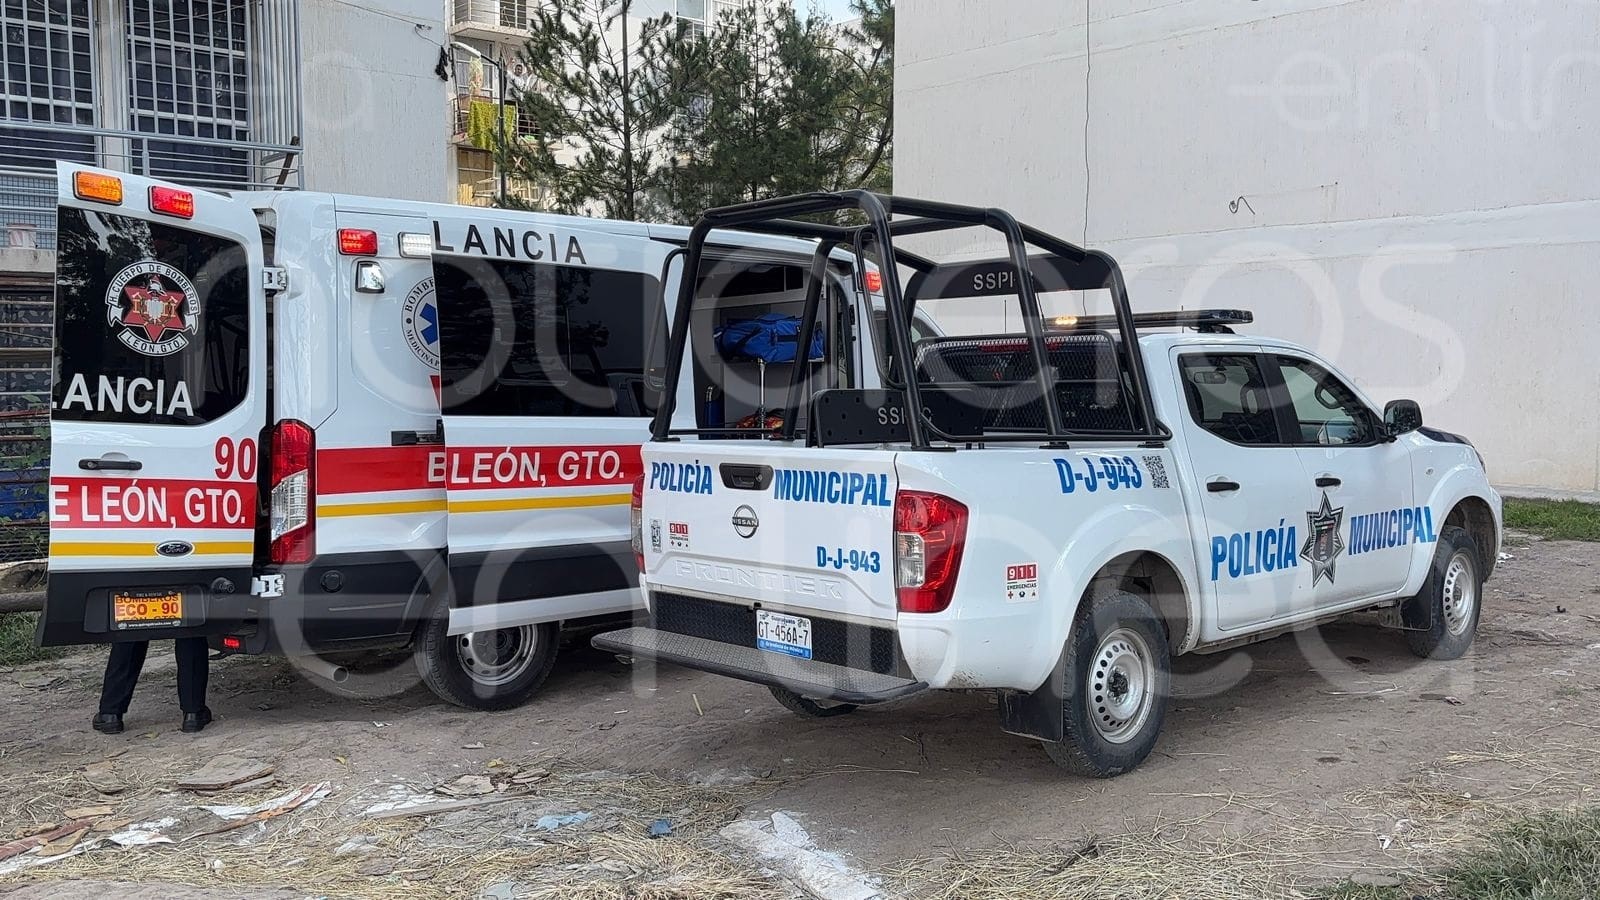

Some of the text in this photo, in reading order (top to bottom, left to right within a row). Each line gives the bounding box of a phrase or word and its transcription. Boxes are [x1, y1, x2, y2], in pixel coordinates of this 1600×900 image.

[433, 220, 587, 265] LANCIA
[113, 265, 143, 294] CUERPO
[149, 264, 164, 273] DE
[165, 268, 198, 311] BOMBEROS
[406, 329, 434, 366] MEDICINA
[51, 373, 194, 416] ANCIA
[215, 437, 257, 480] 90
[451, 446, 625, 486] LEÓN, GTO.
[650, 460, 713, 494] POLICÍA
[1053, 456, 1142, 493] D-J-943
[81, 479, 176, 528] LEÓN,
[184, 487, 245, 524] GTO.
[774, 469, 891, 506] MUNICIPAL
[670, 523, 688, 534] 911
[732, 517, 757, 525] NISSAN
[1348, 506, 1437, 555] MUNICIPAL
[816, 546, 880, 573] D-J-943
[1211, 518, 1297, 581] POLICÍA
[674, 559, 843, 600] FRONTIER
[1009, 566, 1035, 579] 911
[116, 603, 147, 616] ECO
[161, 602, 178, 614] 90
[758, 620, 808, 646] GT-456A-7
